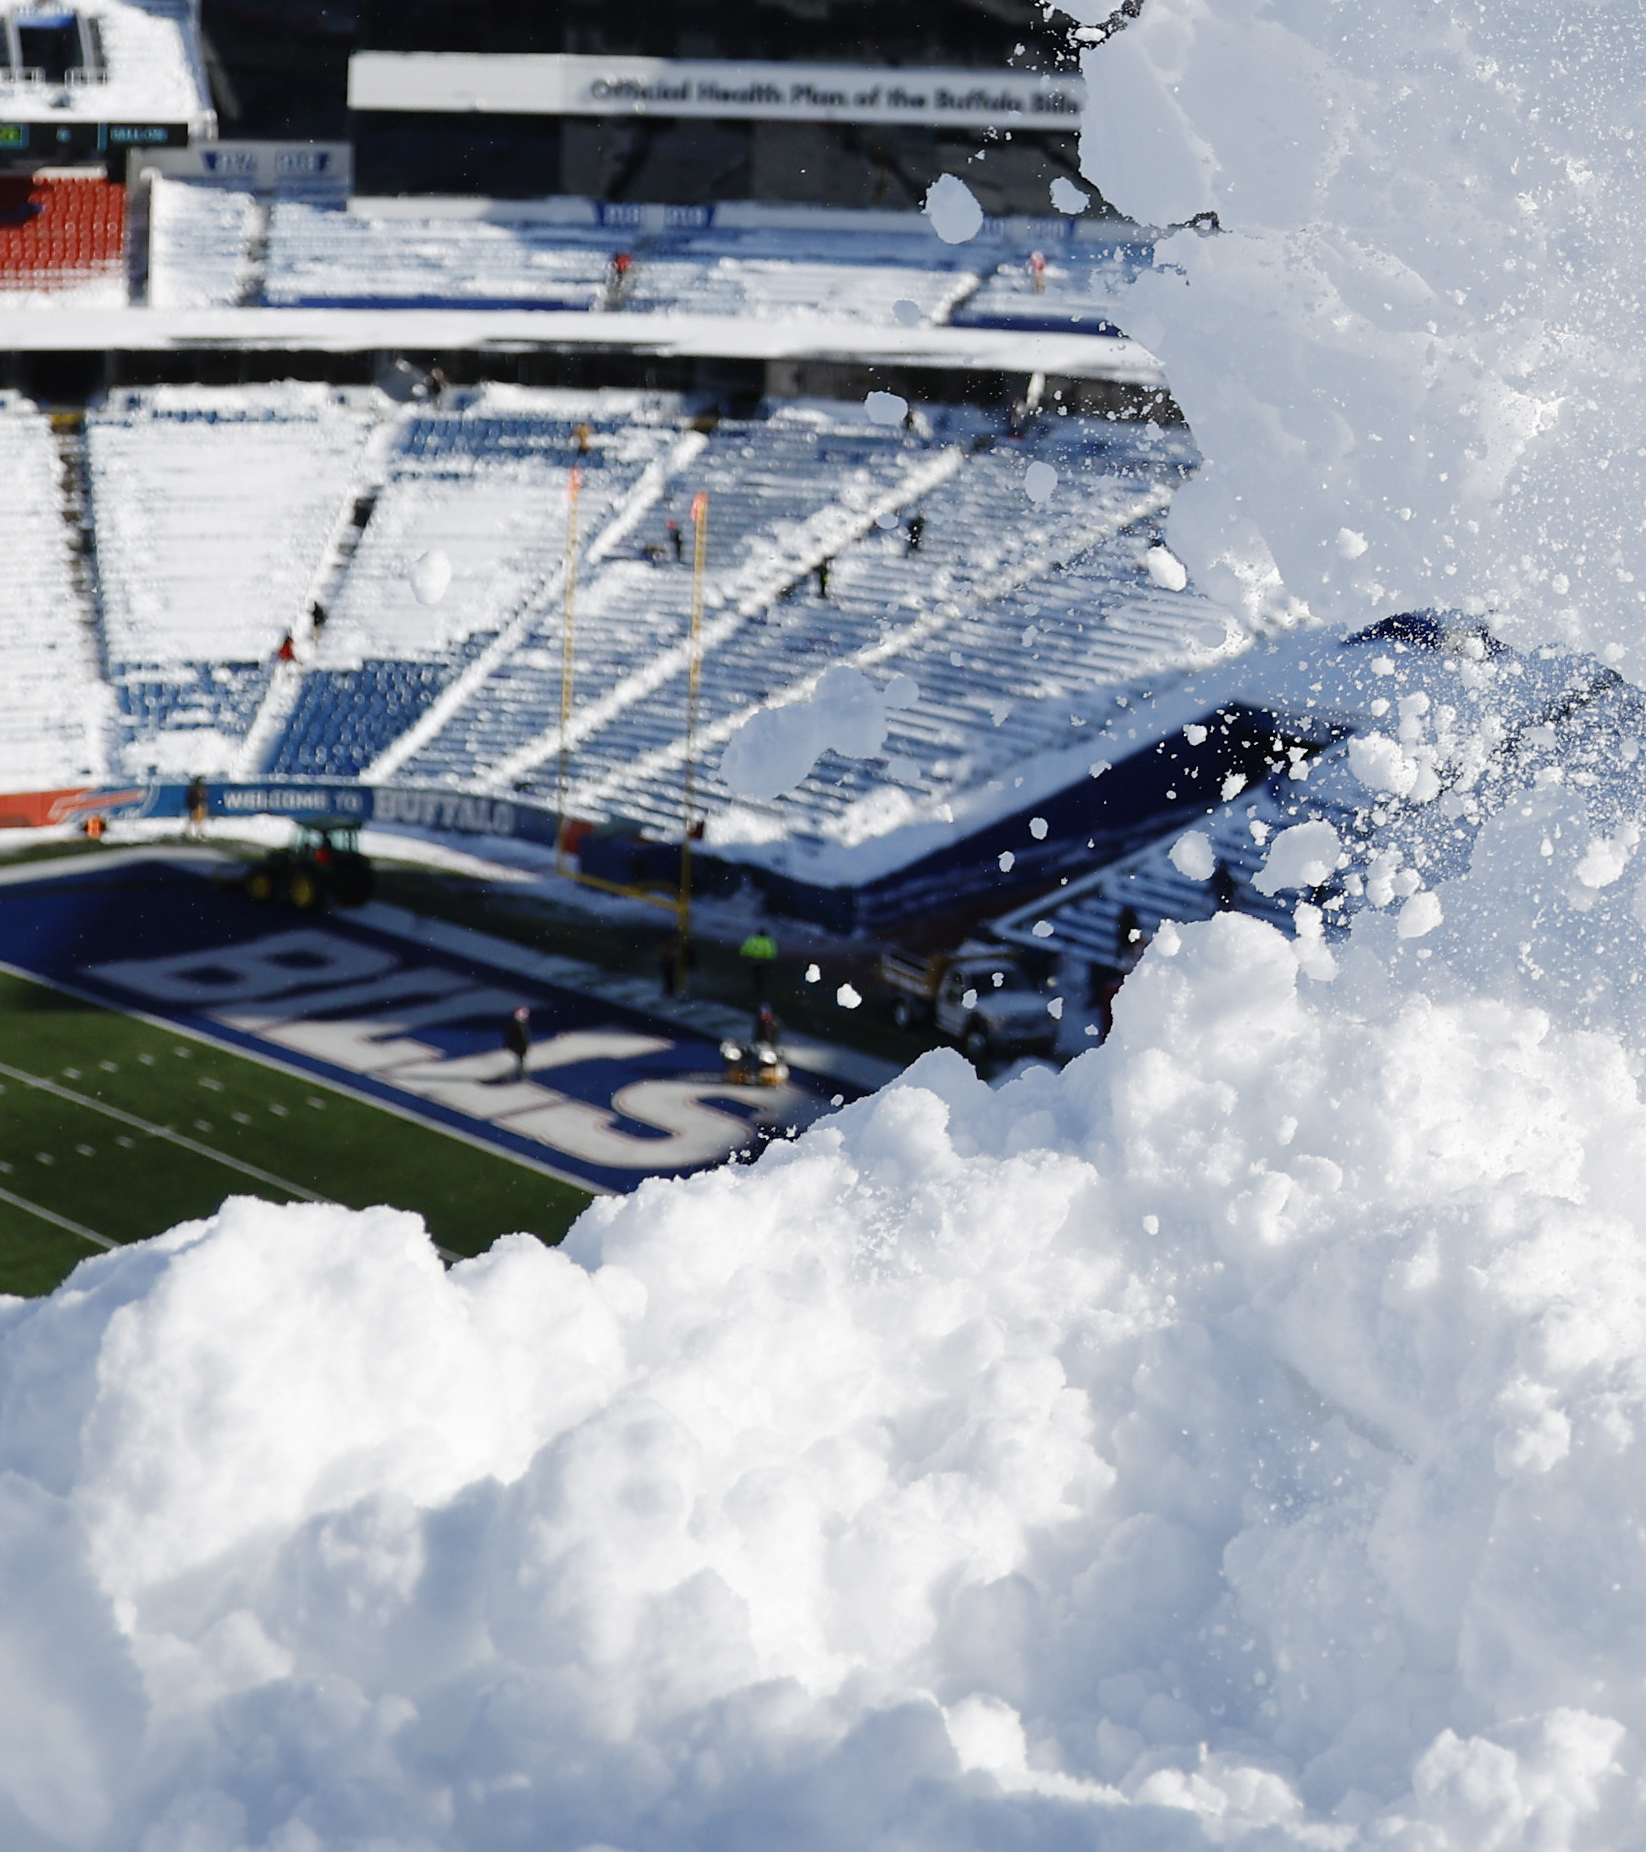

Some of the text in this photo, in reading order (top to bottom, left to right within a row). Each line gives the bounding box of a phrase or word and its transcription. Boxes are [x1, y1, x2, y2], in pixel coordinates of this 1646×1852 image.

[698, 81, 784, 105] Health
[792, 83, 843, 107] Plan
[852, 85, 879, 108] of
[886, 85, 924, 110] the
[935, 87, 1021, 113] Buffalo
[223, 788, 364, 812] WELCOME TO
[372, 787, 515, 835] BUFFALO
[79, 928, 815, 1170] BILLS
